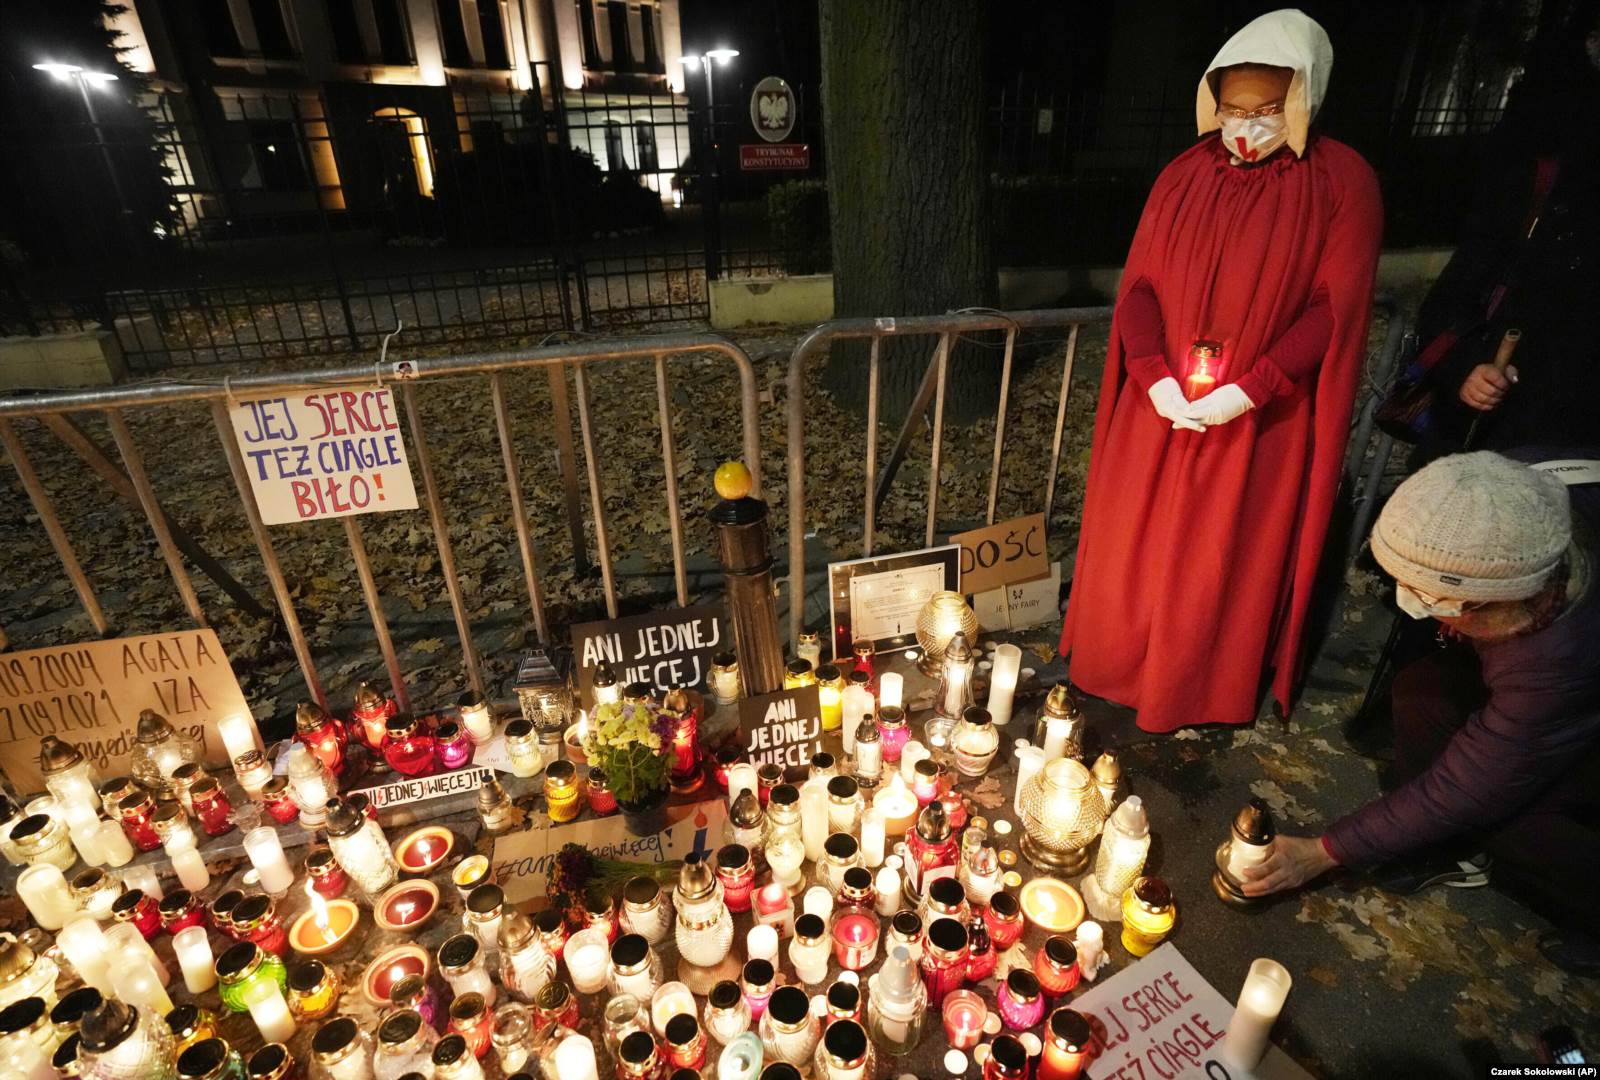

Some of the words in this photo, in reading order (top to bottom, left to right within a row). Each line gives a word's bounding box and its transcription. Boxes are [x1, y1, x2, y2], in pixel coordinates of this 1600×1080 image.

[239, 397, 298, 443] JEJ
[304, 391, 398, 441] SERCE
[291, 473, 386, 518] BIŁO!
[961, 526, 1043, 574] DOŚĆ
[996, 602, 1019, 613] JENY
[1020, 599, 1040, 609] FAIRY
[122, 634, 216, 679] AGATA
[583, 632, 623, 668] ANI
[634, 617, 720, 660] JEDNEJ
[153, 675, 211, 715] IZA
[764, 698, 797, 724] ANI
[747, 717, 820, 753] JEDNEJ
[381, 781, 425, 806] JEDNEJ
[1121, 971, 1194, 1032] SERCE
